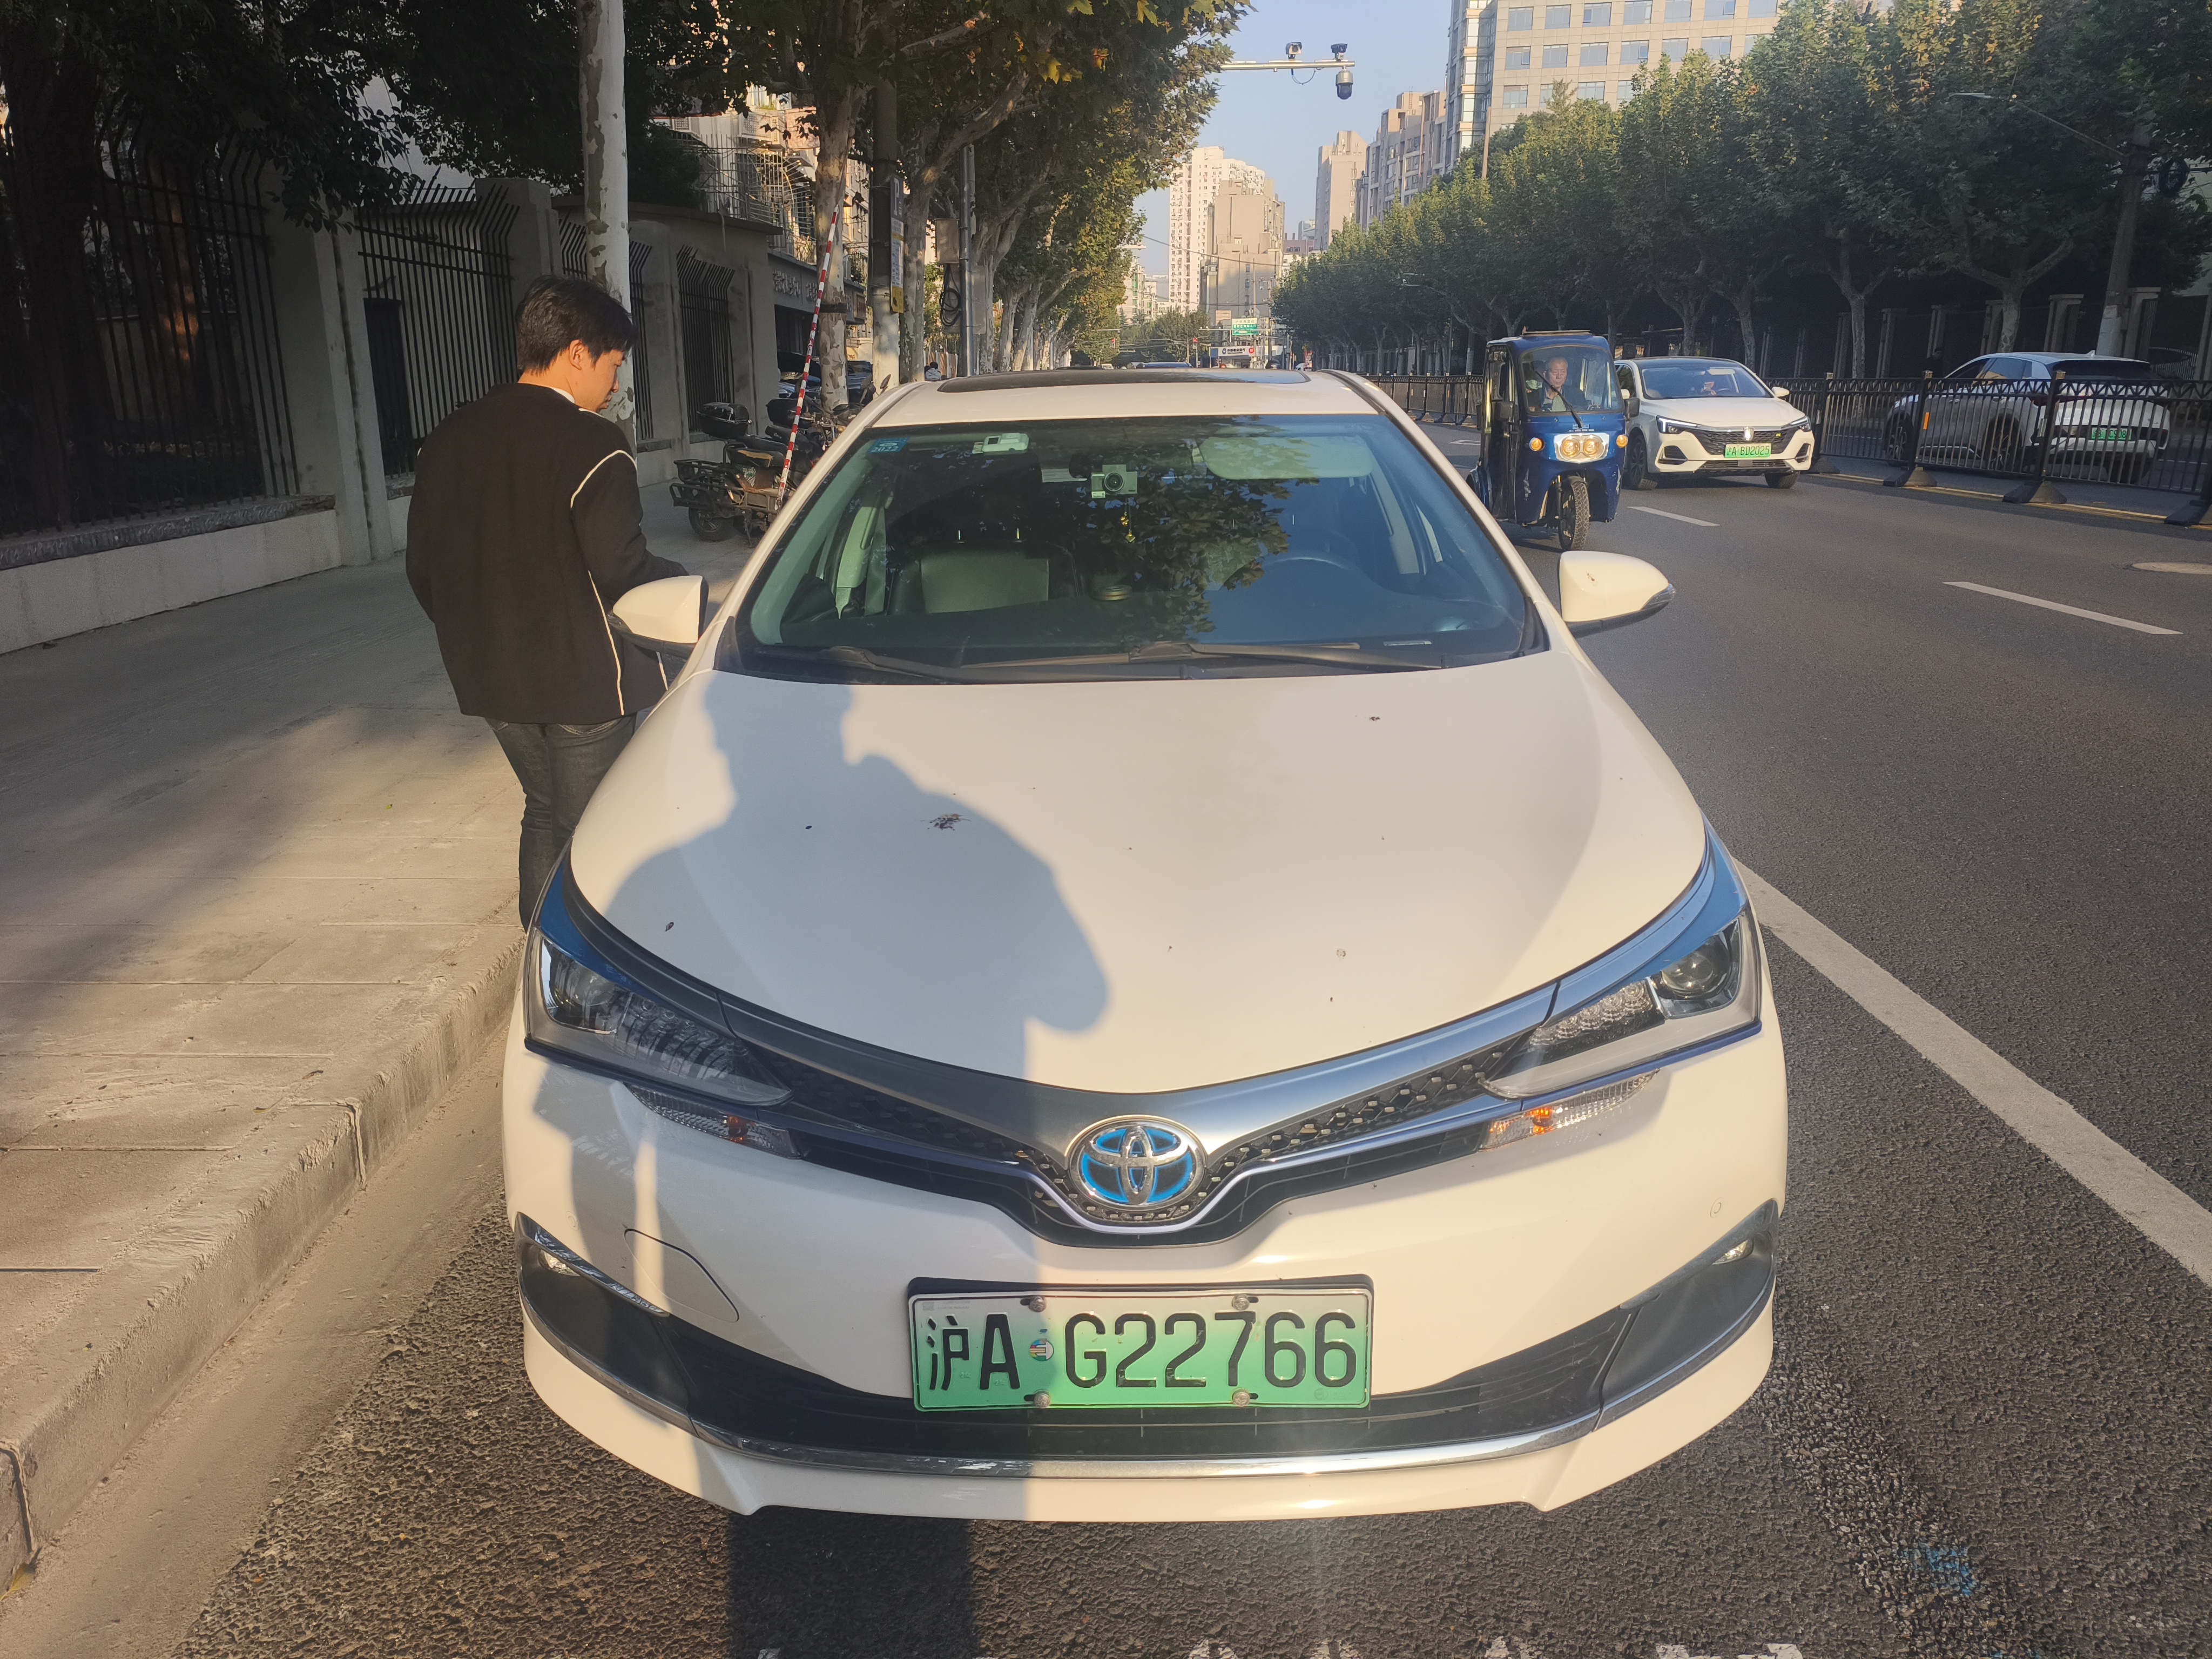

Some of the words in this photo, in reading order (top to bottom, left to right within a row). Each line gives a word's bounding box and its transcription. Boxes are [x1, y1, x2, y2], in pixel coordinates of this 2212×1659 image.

[1727, 446, 1736, 455] 沪A
[1740, 446, 1770, 455] BD2025
[926, 1313, 1020, 1391] 沪A
[1064, 1311, 1357, 1388] G22766
